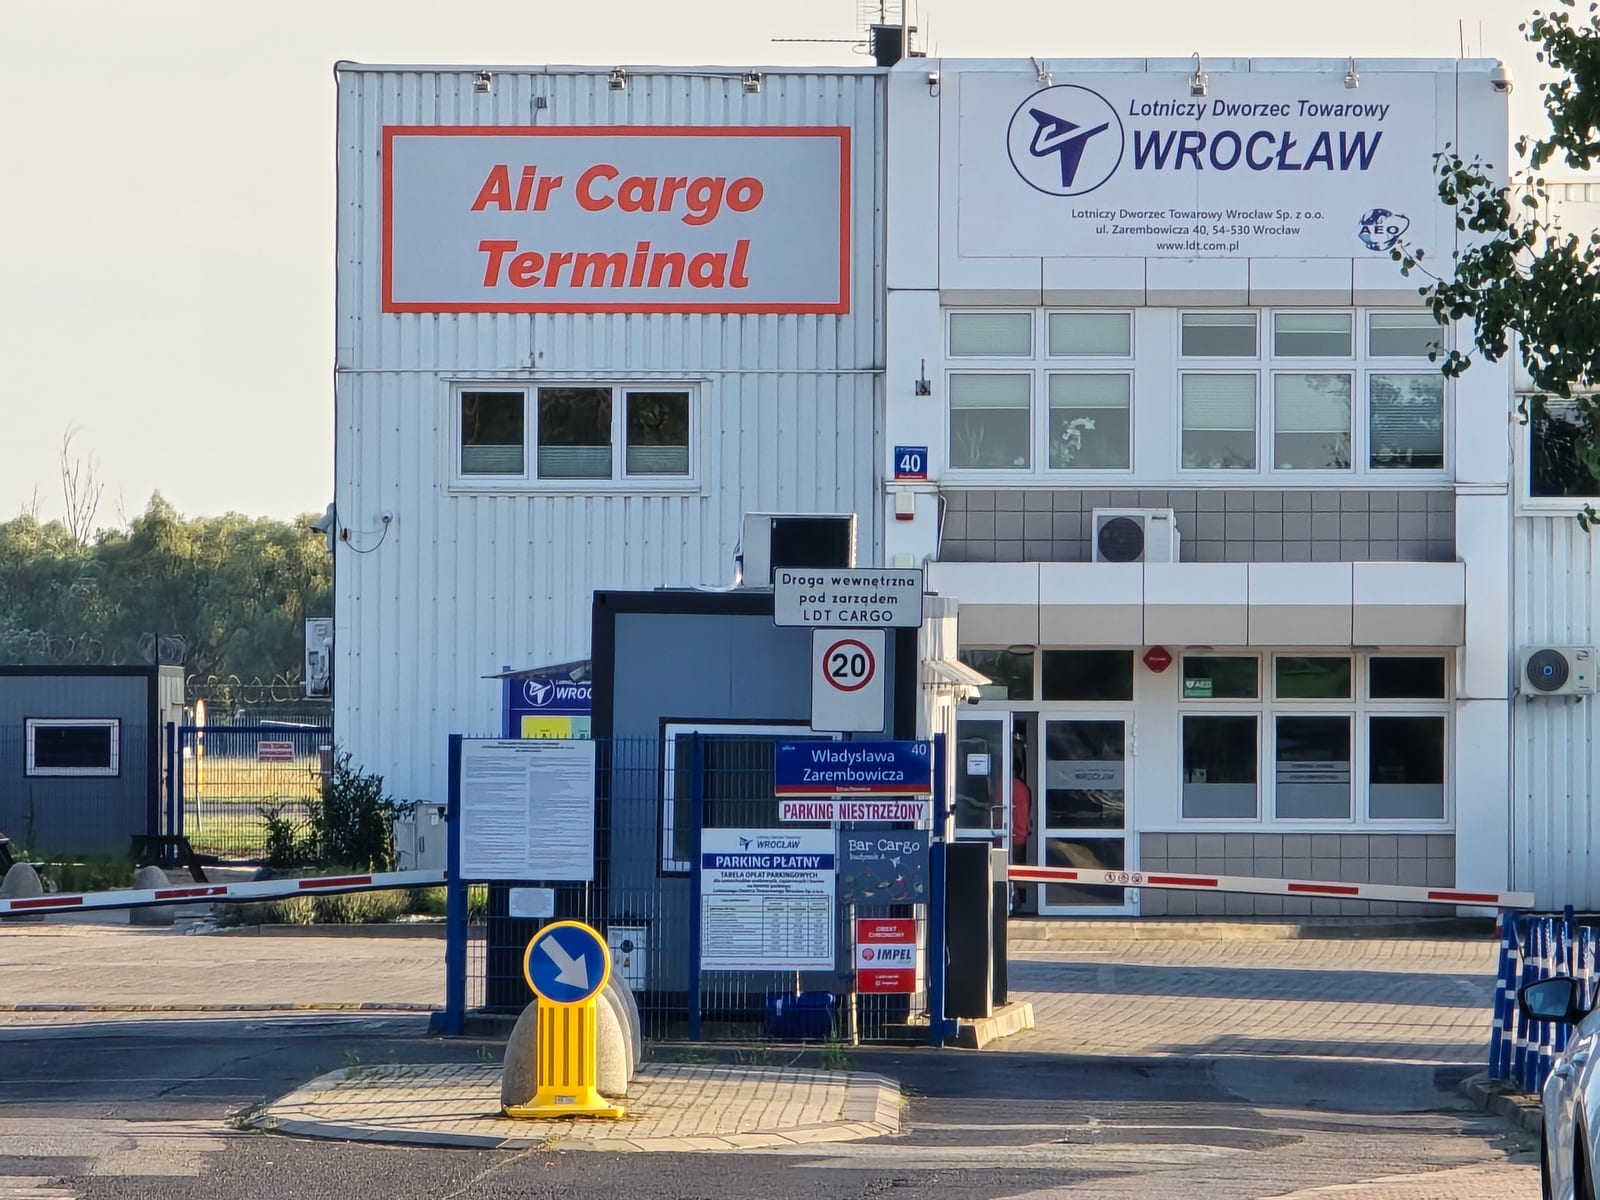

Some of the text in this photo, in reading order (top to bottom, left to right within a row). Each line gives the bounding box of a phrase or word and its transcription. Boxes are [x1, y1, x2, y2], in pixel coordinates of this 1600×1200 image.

[1129, 99, 1390, 121] Lotniczy Dworzec Towarowy
[1133, 129, 1383, 171] WROCŁAW
[470, 163, 765, 226] Air Cargo
[1071, 208, 1116, 220] Lotniczy
[1119, 209, 1166, 219] Dworzec
[1169, 209, 1223, 220] Towarowy
[1276, 209, 1293, 221] Sp.
[1295, 211, 1302, 219] z
[1304, 211, 1325, 219] o.o.
[1096, 224, 1109, 235] ul.
[1111, 224, 1190, 235] Zarembowicza
[1192, 225, 1209, 236] 40,
[1212, 225, 1250, 235] 54-530
[1359, 225, 1399, 235] AEO
[1156, 240, 1240, 253] www.ldt.com.pl
[477, 239, 751, 289] Terminal
[900, 454, 921, 472] 40
[782, 573, 915, 589] Droga wewnętrzna
[799, 592, 898, 607] pod zarządem
[803, 610, 893, 622] LDT CARGO
[831, 653, 866, 678] 20
[811, 748, 895, 766] Władysława
[911, 743, 927, 756] 40
[803, 767, 904, 782] Zarembowicza
[783, 801, 923, 820] PARKING NIESTRZEŻONY
[757, 840, 801, 849] WROCŁAW
[848, 839, 920, 854] Bar Cargo
[715, 855, 821, 868] PARKING PŁATNY
[877, 948, 912, 961] IMPEL
